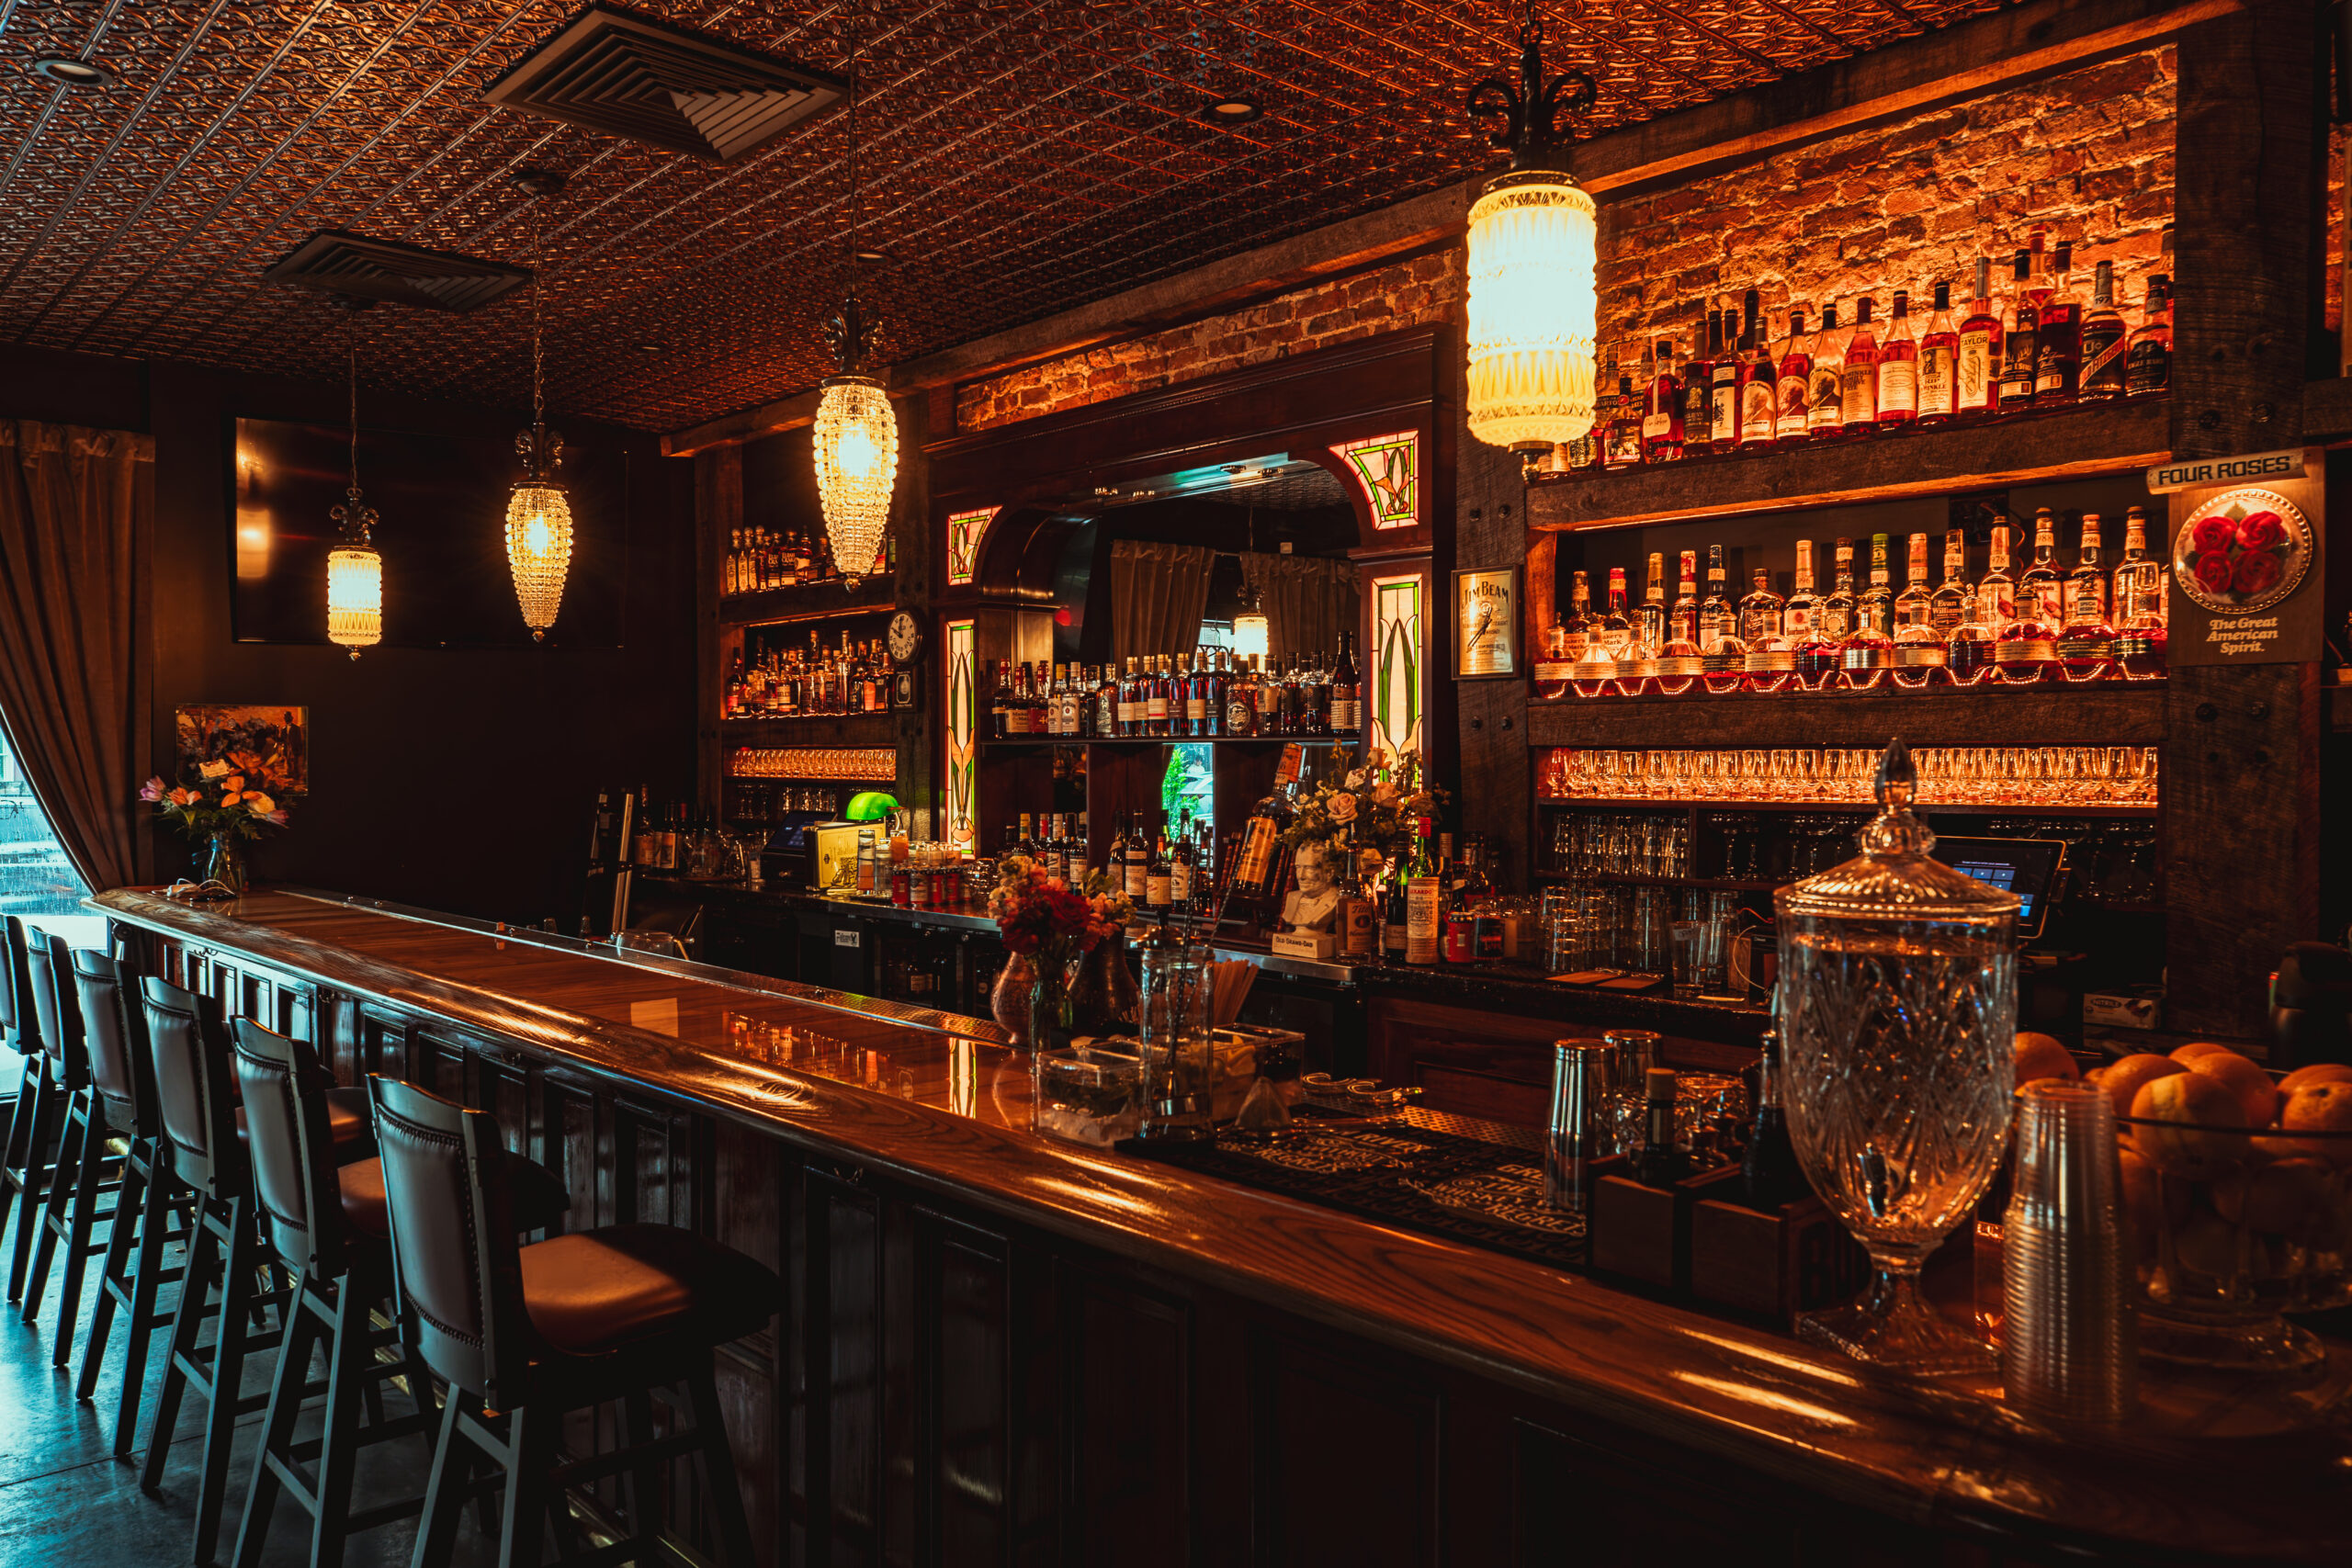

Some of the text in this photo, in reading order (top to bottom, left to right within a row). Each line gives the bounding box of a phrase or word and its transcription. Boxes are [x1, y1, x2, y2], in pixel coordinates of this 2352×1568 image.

[1961, 336, 1988, 345] TAYLOR
[2159, 456, 2290, 485] FOUR ROSES
[1482, 581, 1509, 603] BEAM
[2209, 616, 2278, 631] The Great
[2205, 628, 2278, 642] American
[2220, 641, 2265, 656] Spirit.
[1275, 935, 1314, 948] OLD GRAND-DAD
[1497, 1164, 1544, 1181] GRE
[1484, 1202, 1582, 1232] REGRET
